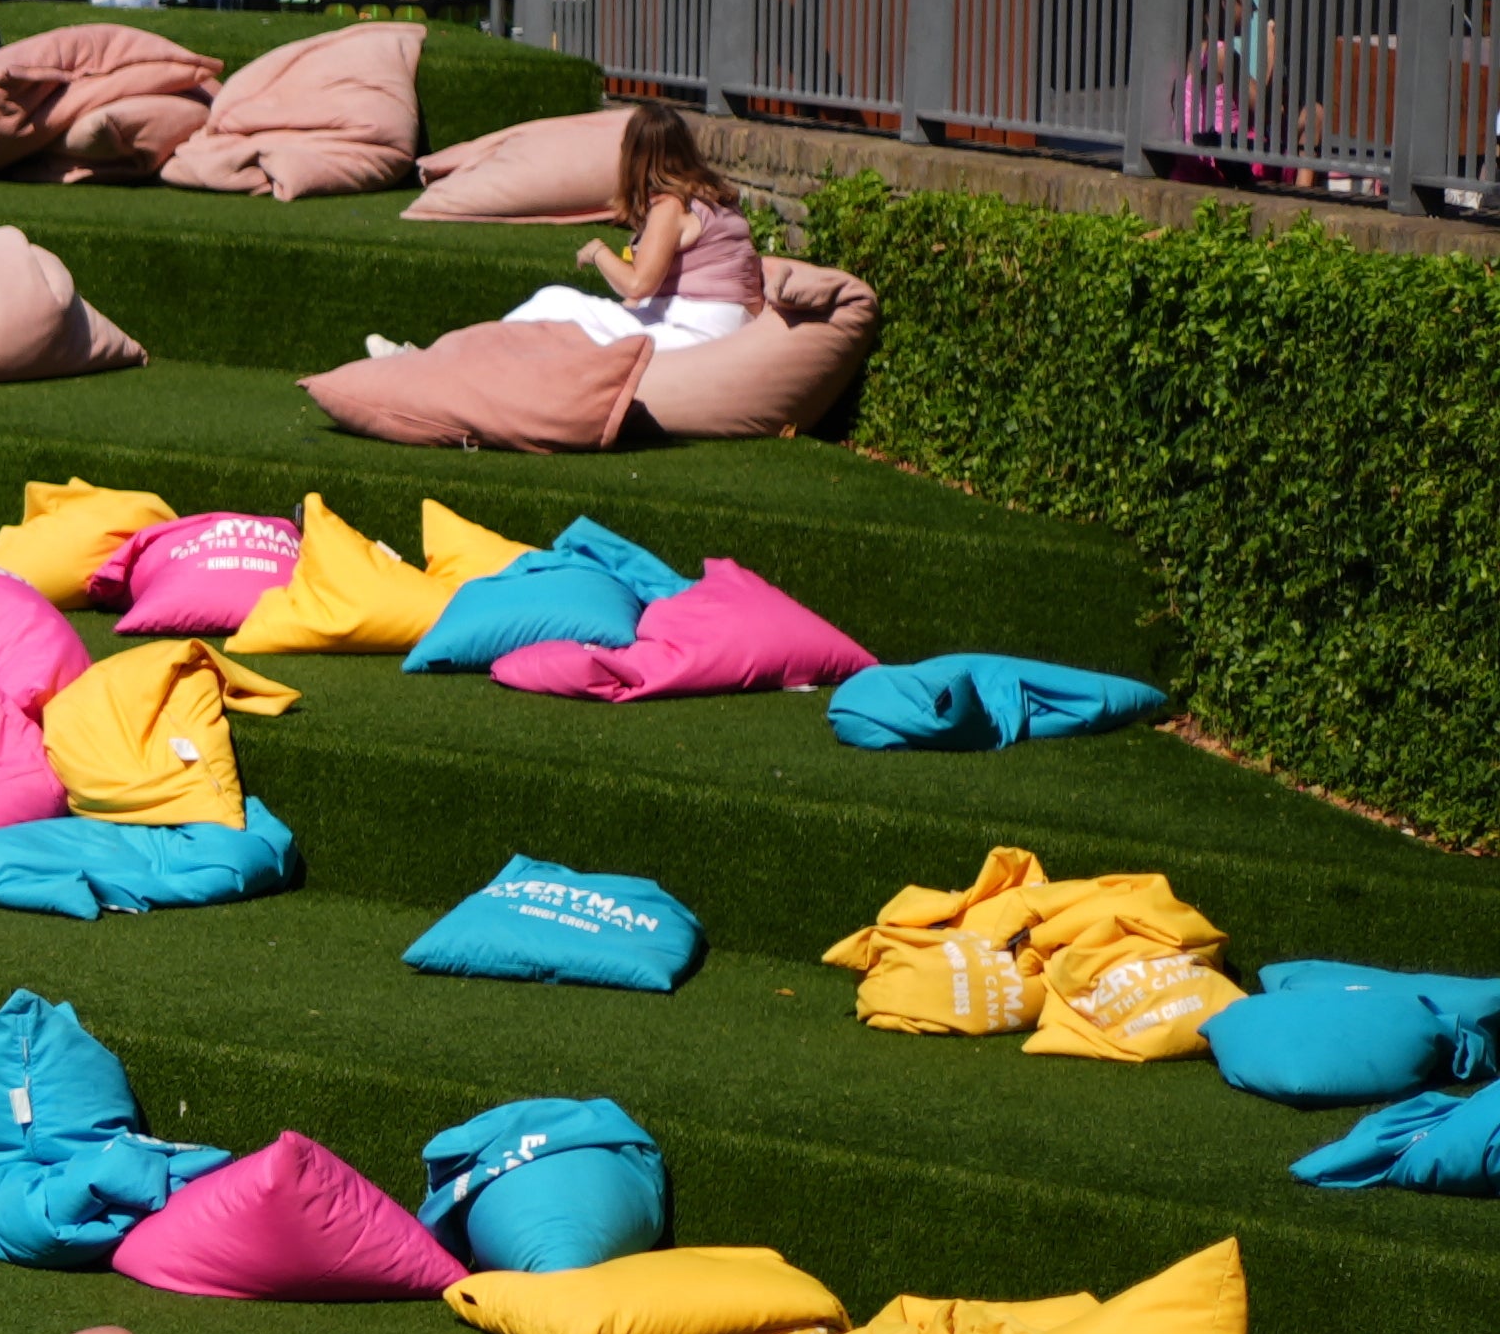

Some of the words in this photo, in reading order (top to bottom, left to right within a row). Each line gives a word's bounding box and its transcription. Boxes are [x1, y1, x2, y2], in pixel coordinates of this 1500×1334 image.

[207, 537, 238, 549] THE
[482, 880, 659, 932] EVERYMAN
[985, 976, 999, 1031] CANA
